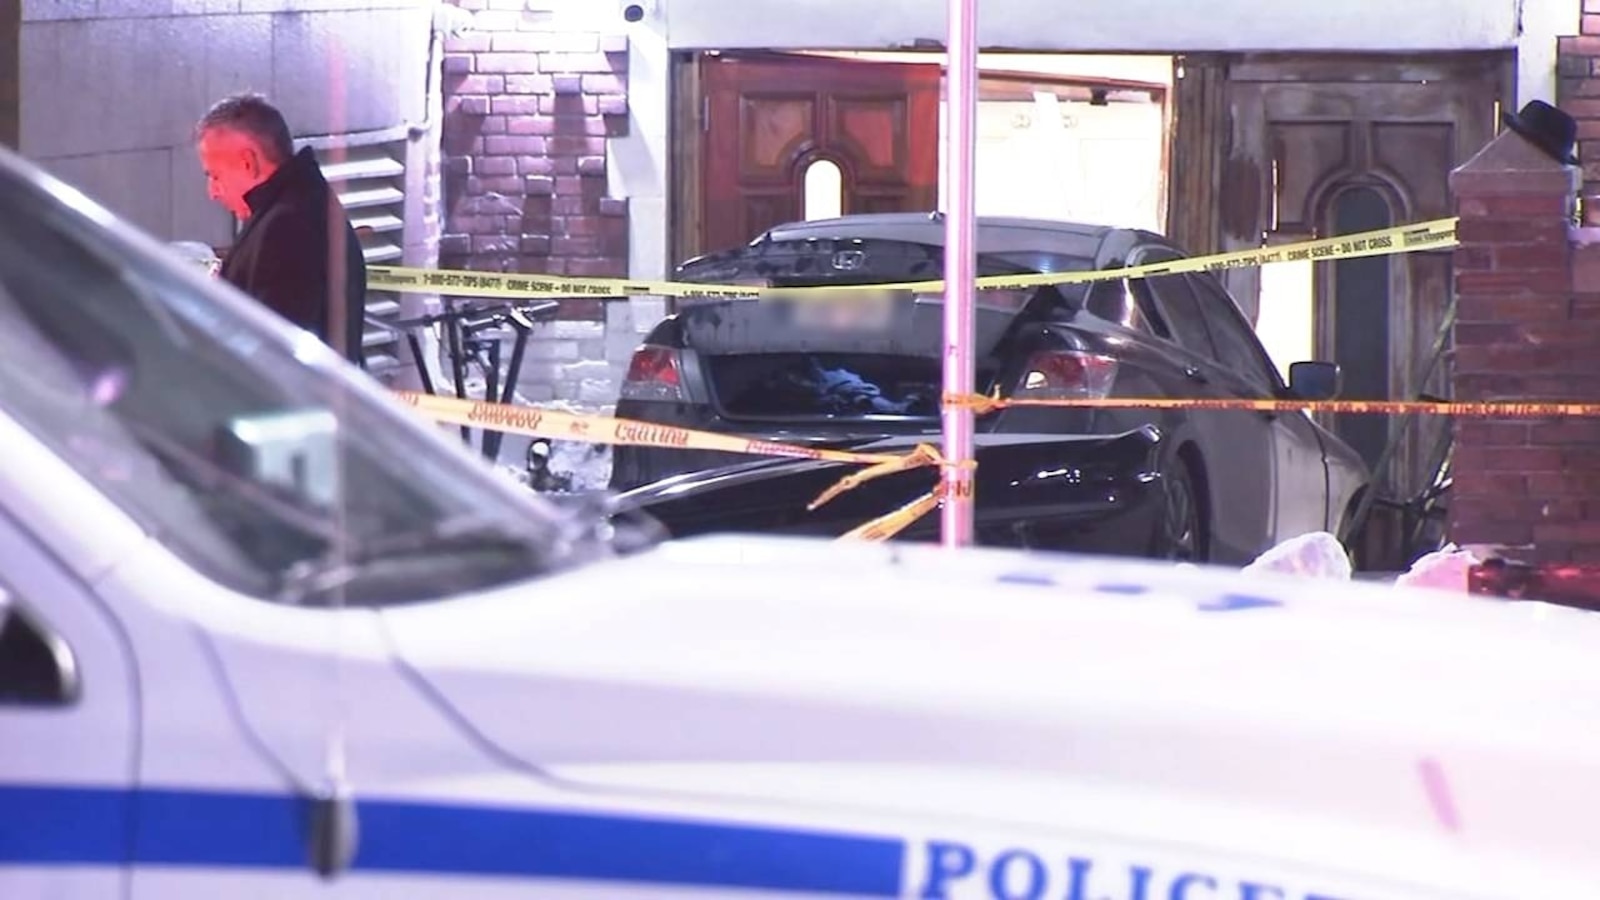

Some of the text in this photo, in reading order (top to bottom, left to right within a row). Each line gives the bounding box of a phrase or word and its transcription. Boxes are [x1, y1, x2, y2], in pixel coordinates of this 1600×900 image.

[1287, 249, 1310, 261] CRIME
[1311, 244, 1334, 258] SCENE
[1341, 240, 1352, 254] DO
[1353, 239, 1367, 252] NOT
[1368, 235, 1393, 250] CROSS
[506, 279, 530, 292] CRIME
[530, 280, 555, 293] SCENE
[560, 283, 572, 293] DO
[573, 284, 587, 294] NOT
